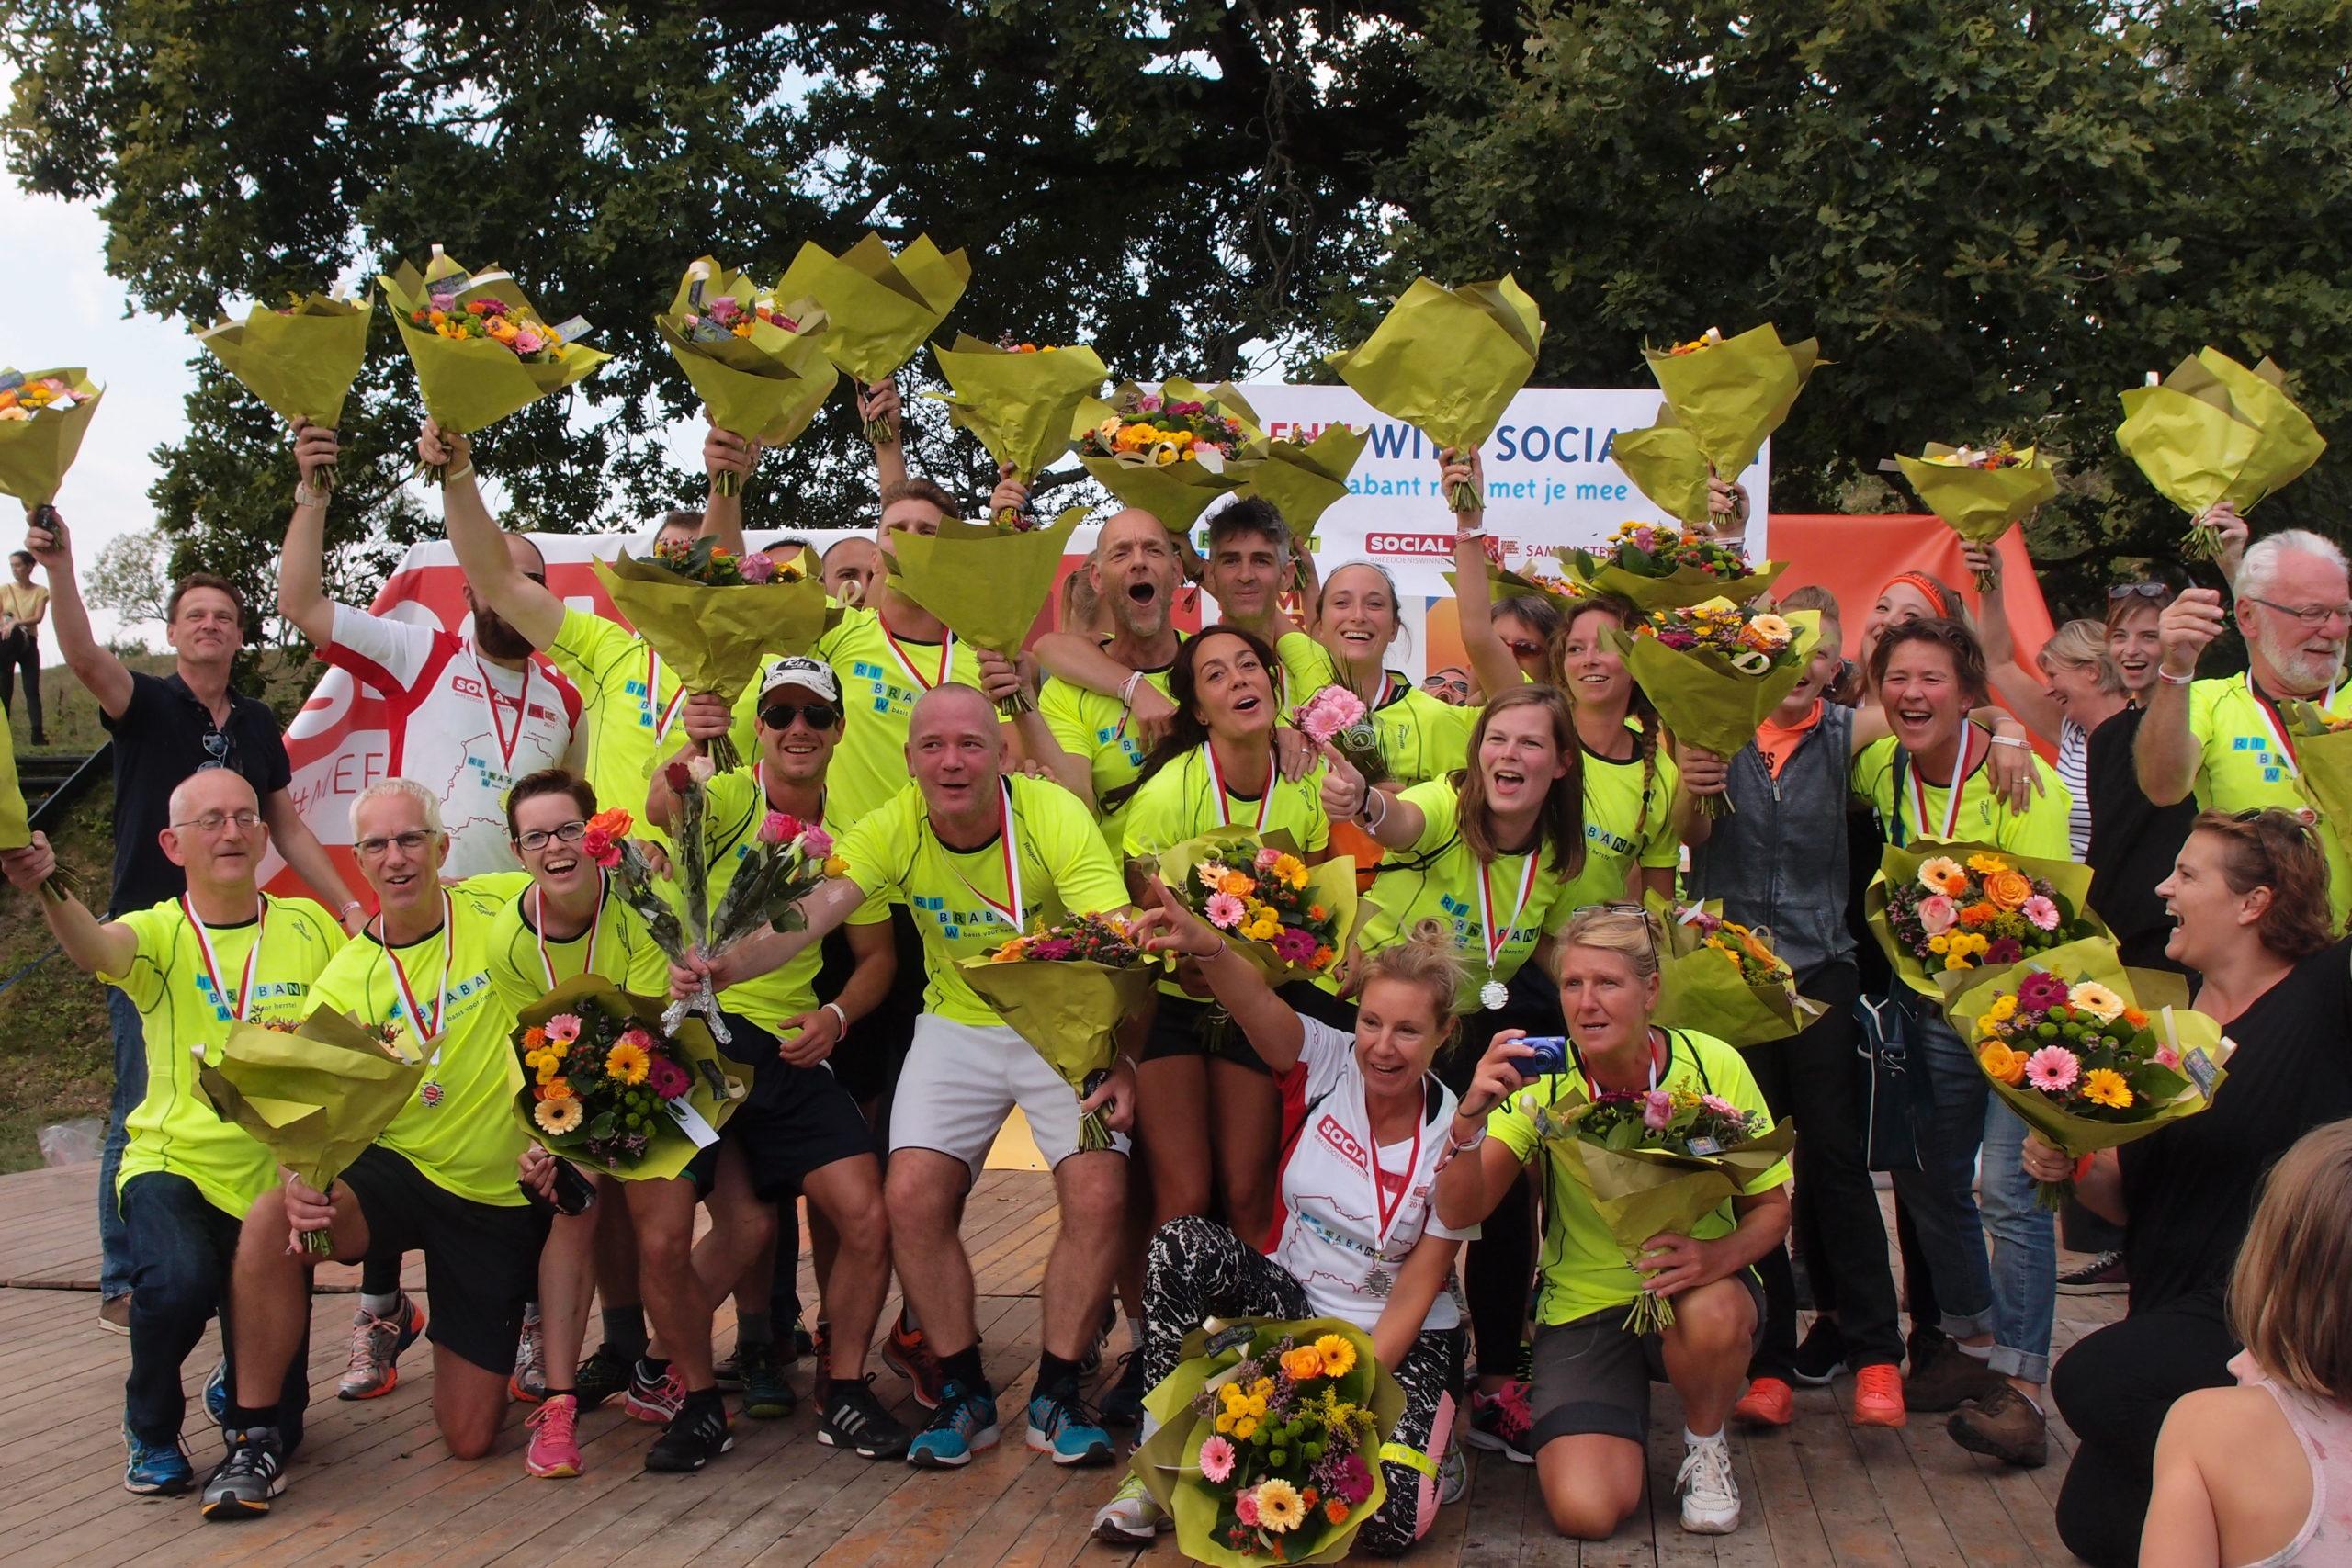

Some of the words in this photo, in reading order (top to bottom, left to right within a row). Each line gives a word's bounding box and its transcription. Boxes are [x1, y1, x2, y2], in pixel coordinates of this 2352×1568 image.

[1495, 424, 1640, 463] SOCIA
[1345, 473, 1421, 496] abant
[1489, 479, 1536, 499] met
[1544, 477, 1566, 506] je
[1576, 484, 1628, 501] mee
[1370, 536, 1451, 553] SOCIAL
[1321, 1119, 1367, 1170] SOCIA
